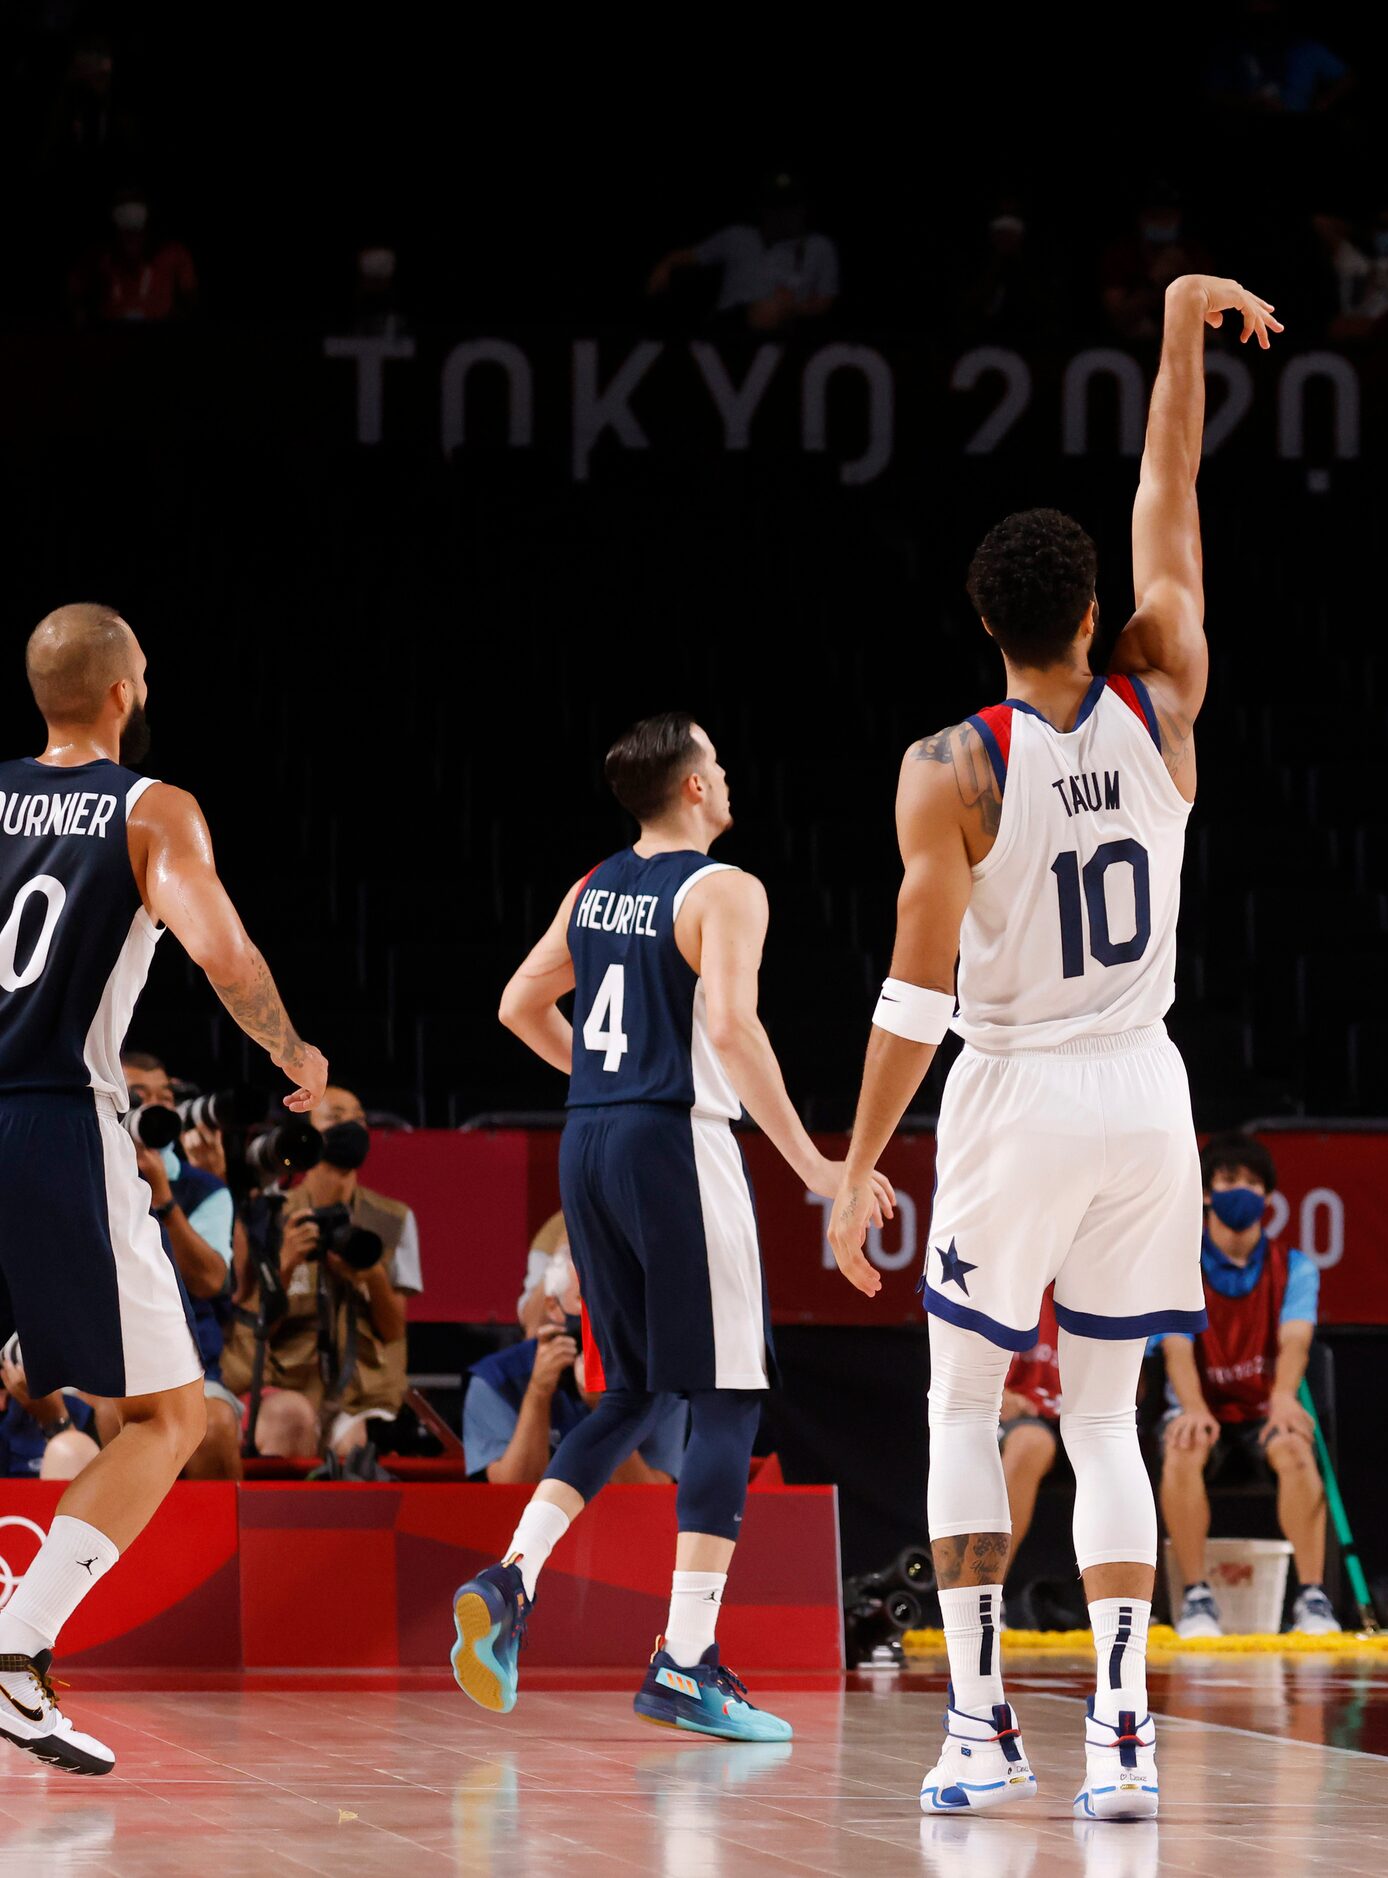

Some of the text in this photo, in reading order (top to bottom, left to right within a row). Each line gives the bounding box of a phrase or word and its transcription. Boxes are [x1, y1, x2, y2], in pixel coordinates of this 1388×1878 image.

[322, 334, 896, 487] TOKYO
[0, 791, 118, 838] URNIER
[1051, 770, 1121, 818] TAUM
[1050, 837, 1151, 979] 10
[582, 963, 628, 1073] 4
